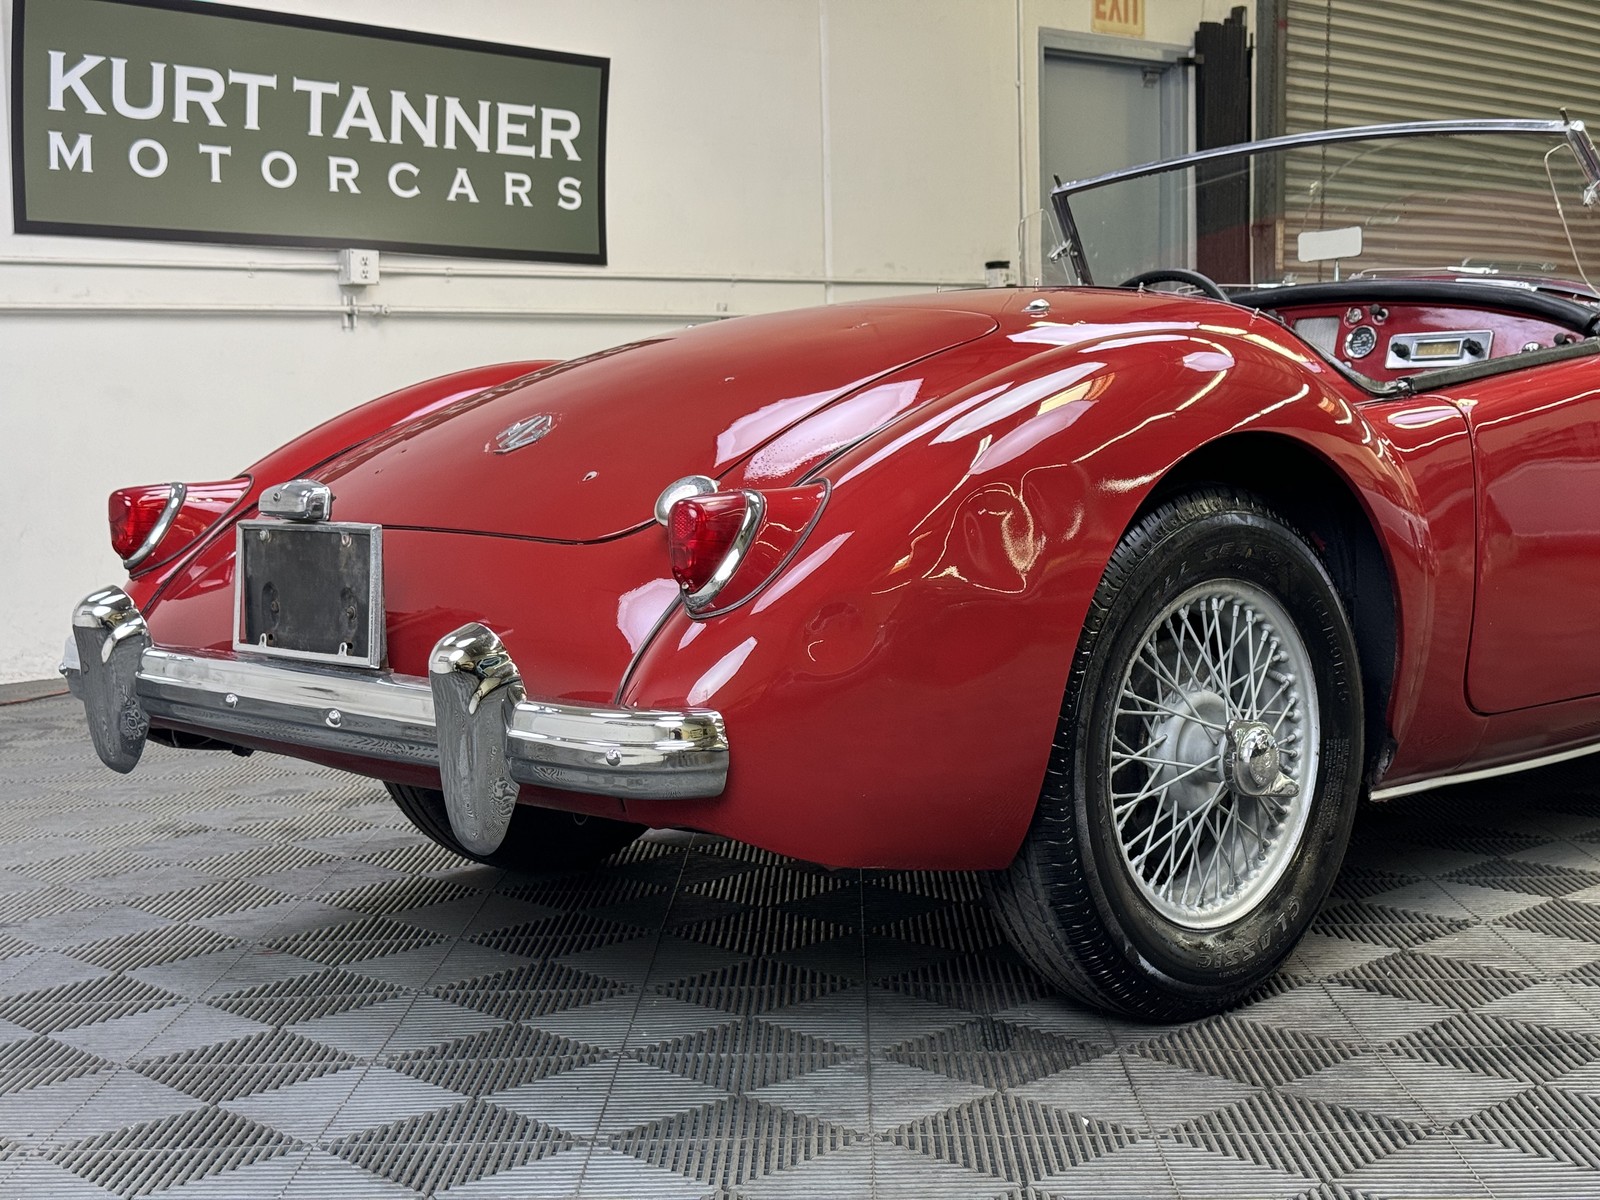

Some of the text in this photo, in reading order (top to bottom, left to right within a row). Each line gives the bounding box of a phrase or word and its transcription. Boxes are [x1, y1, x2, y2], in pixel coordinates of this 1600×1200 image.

[47, 49, 583, 162] KURT TANNER
[47, 130, 583, 211] MOTORCARS
[1195, 896, 1300, 969] CLASSIC
